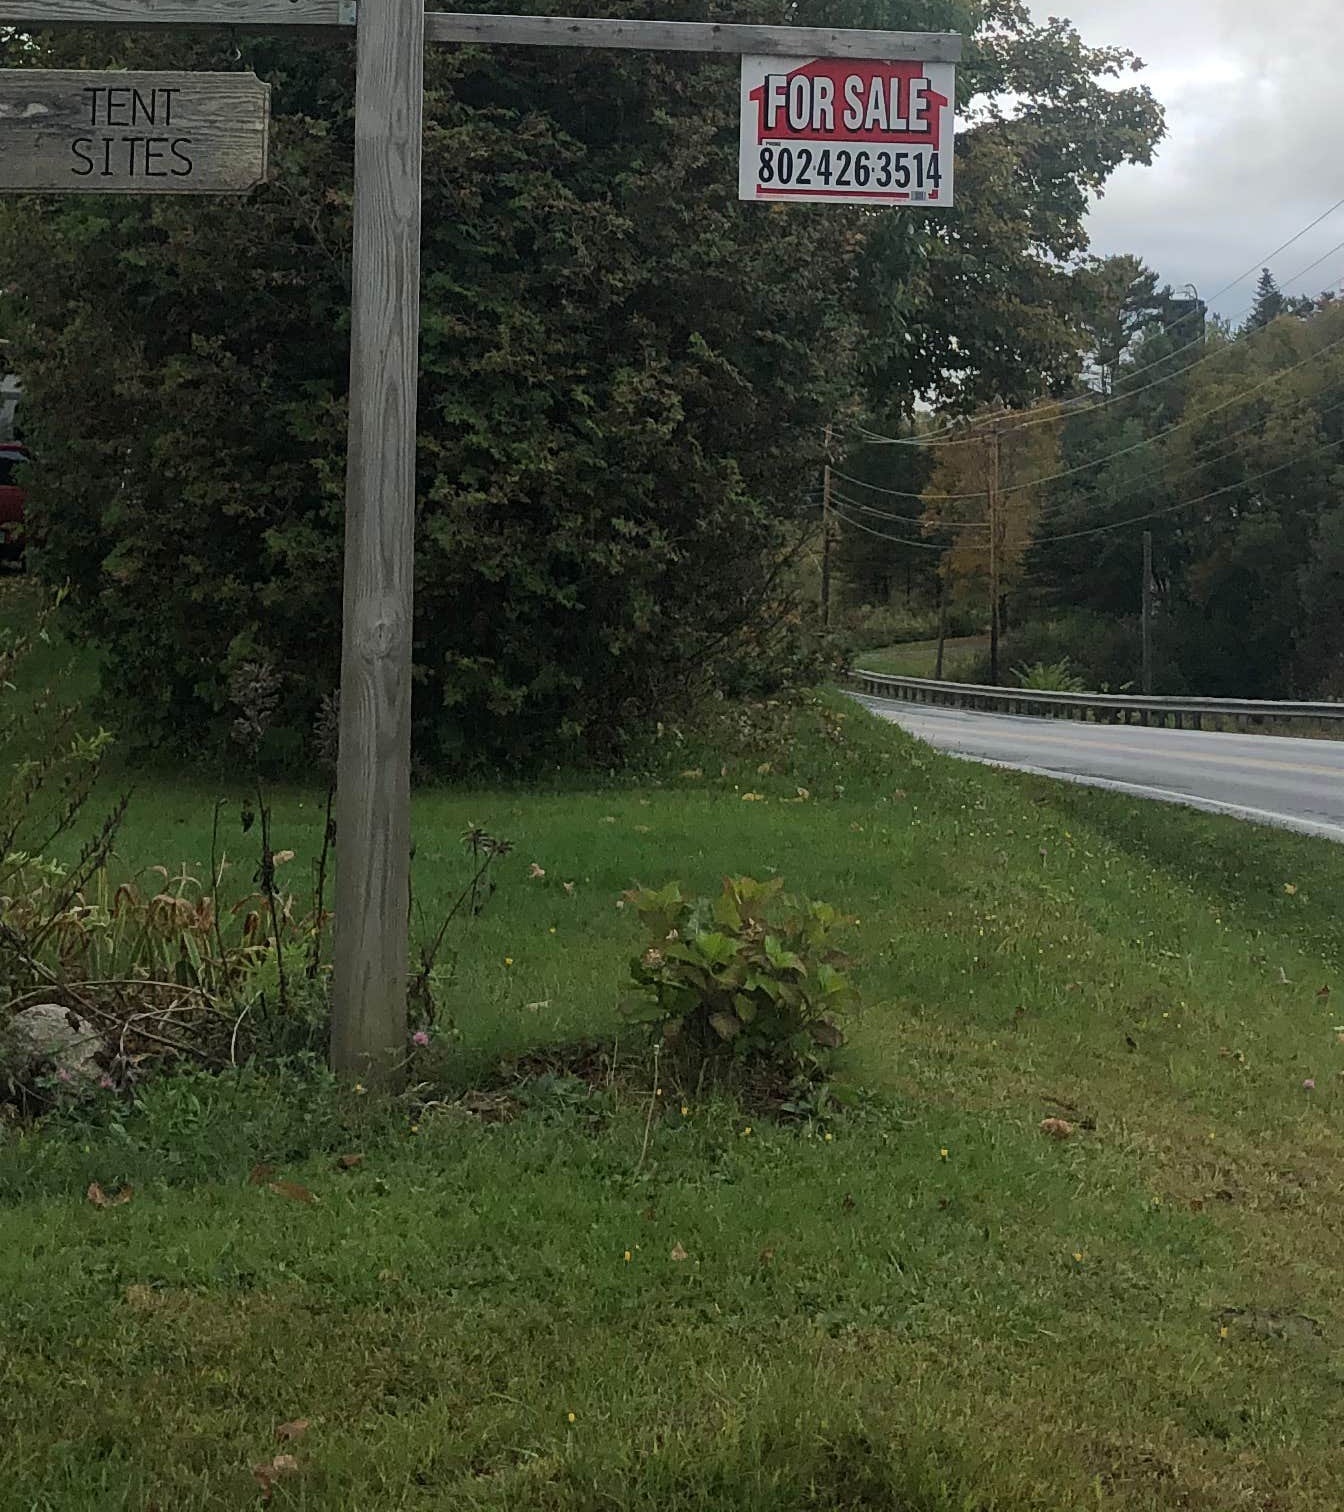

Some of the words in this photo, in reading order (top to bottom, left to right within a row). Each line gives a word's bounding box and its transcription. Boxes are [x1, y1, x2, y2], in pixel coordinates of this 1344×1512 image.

[82, 88, 181, 127] TENT
[765, 74, 835, 132] FOR
[843, 74, 931, 133] SALE
[71, 137, 193, 177] SITES
